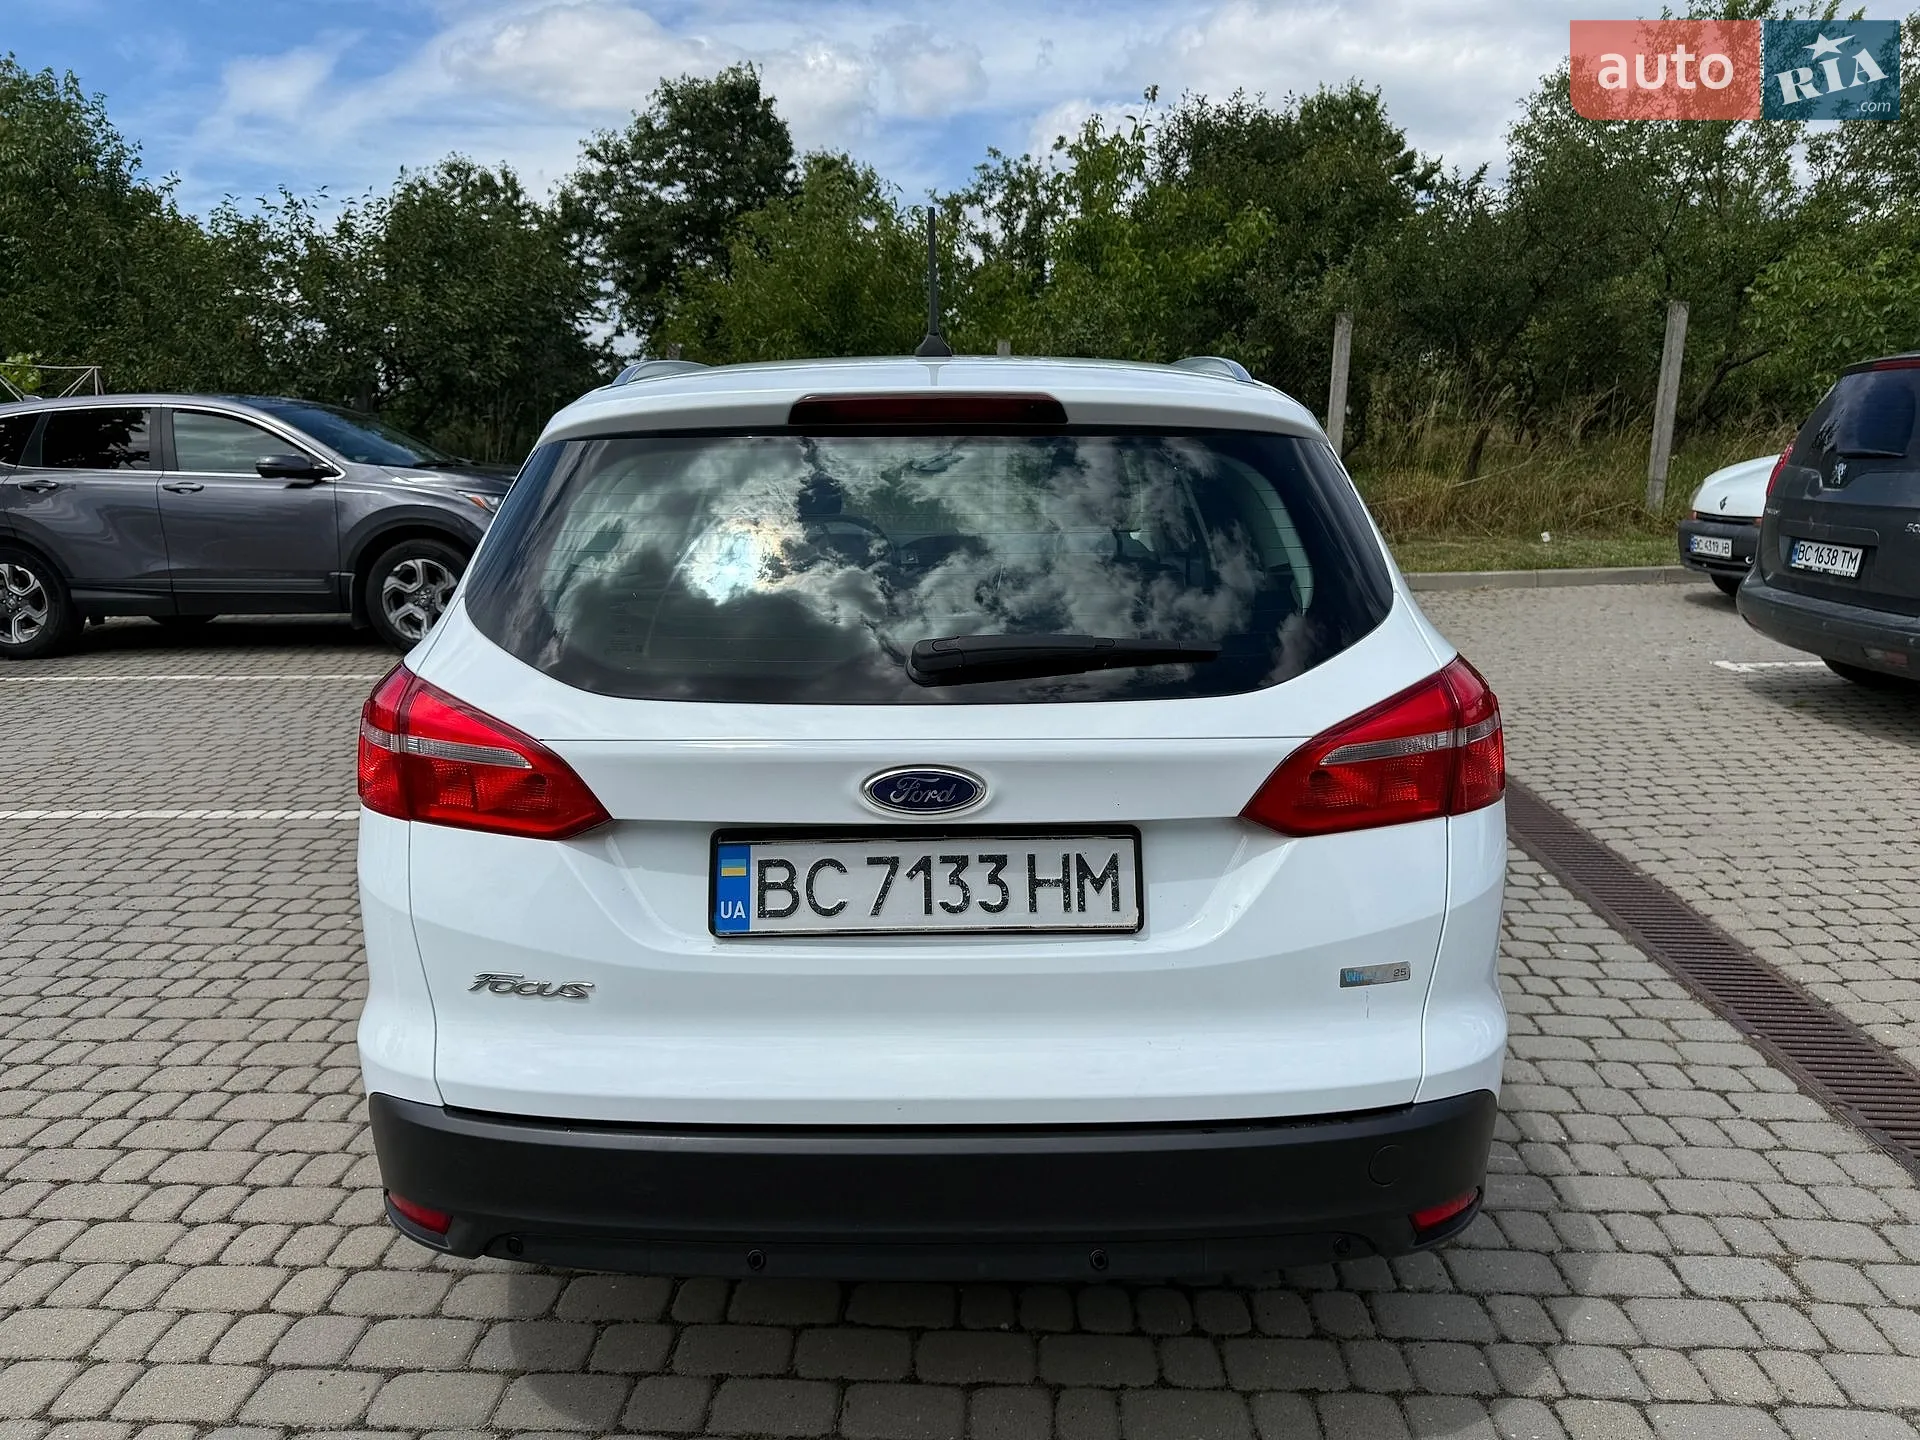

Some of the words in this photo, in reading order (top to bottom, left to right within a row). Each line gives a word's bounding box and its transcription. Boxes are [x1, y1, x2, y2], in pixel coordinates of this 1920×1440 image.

[1797, 543, 1813, 562] BC
[1814, 546, 1839, 566] 1638
[1841, 550, 1860, 571] TM
[889, 776, 957, 803] Ford
[757, 858, 848, 918] BC
[866, 854, 1010, 916] 7133
[1027, 853, 1120, 913] HM
[720, 900, 747, 919] UA
[1393, 967, 1407, 977] 25
